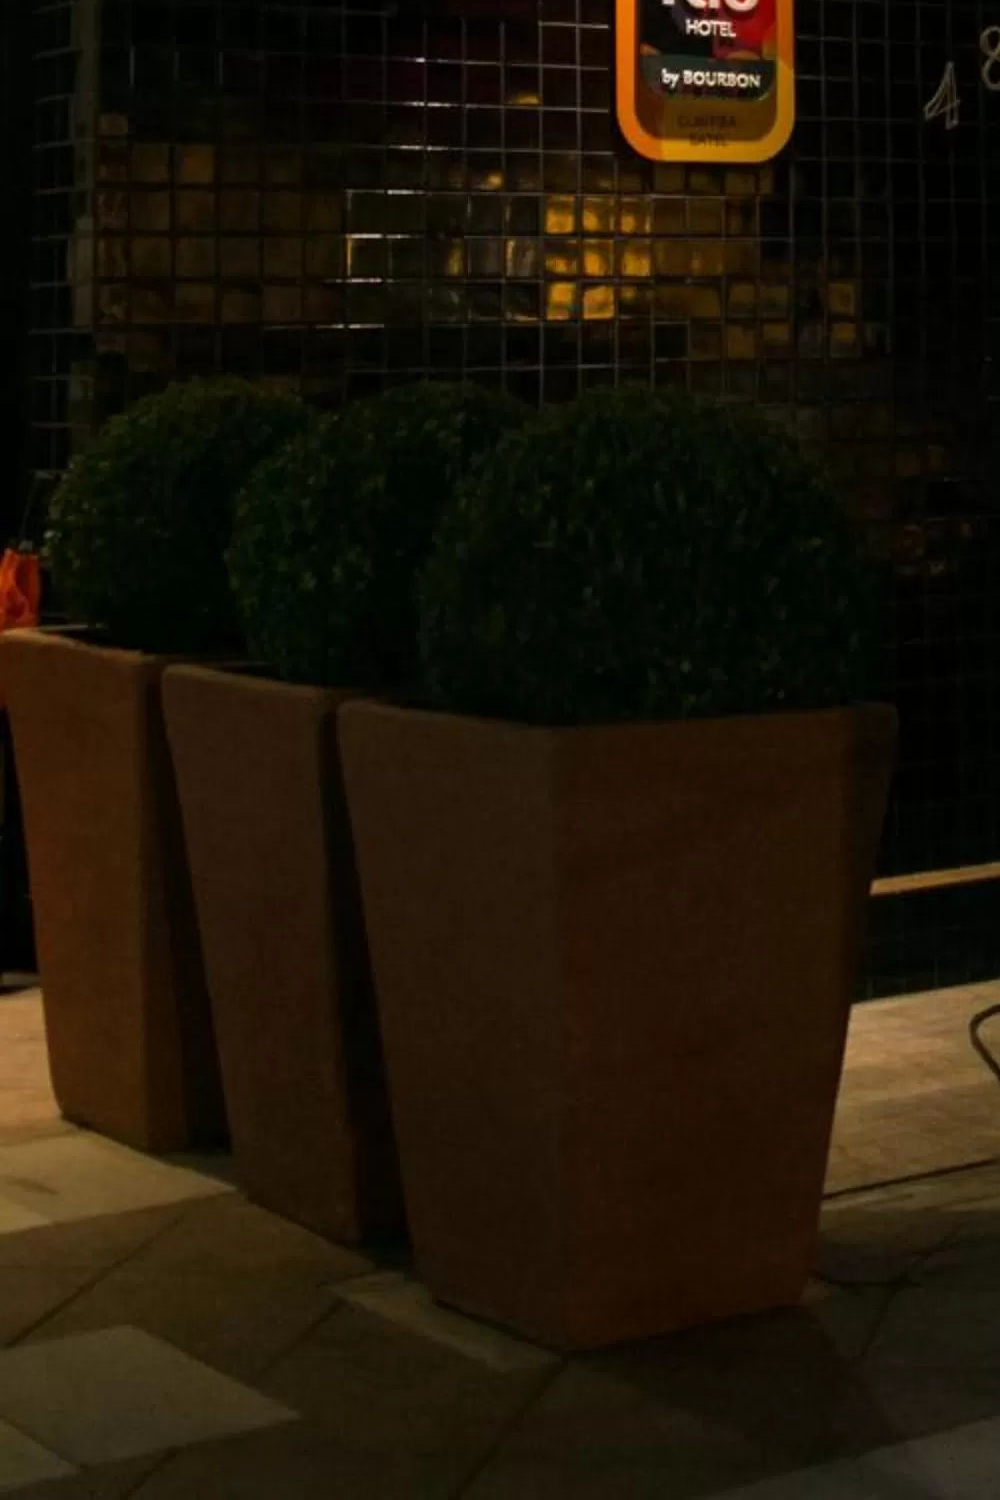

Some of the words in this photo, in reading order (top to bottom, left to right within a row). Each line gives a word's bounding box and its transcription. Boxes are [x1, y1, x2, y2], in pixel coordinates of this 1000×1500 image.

[685, 18, 737, 38] HOTEL
[661, 69, 680, 88] by
[683, 70, 762, 88] BOURBON
